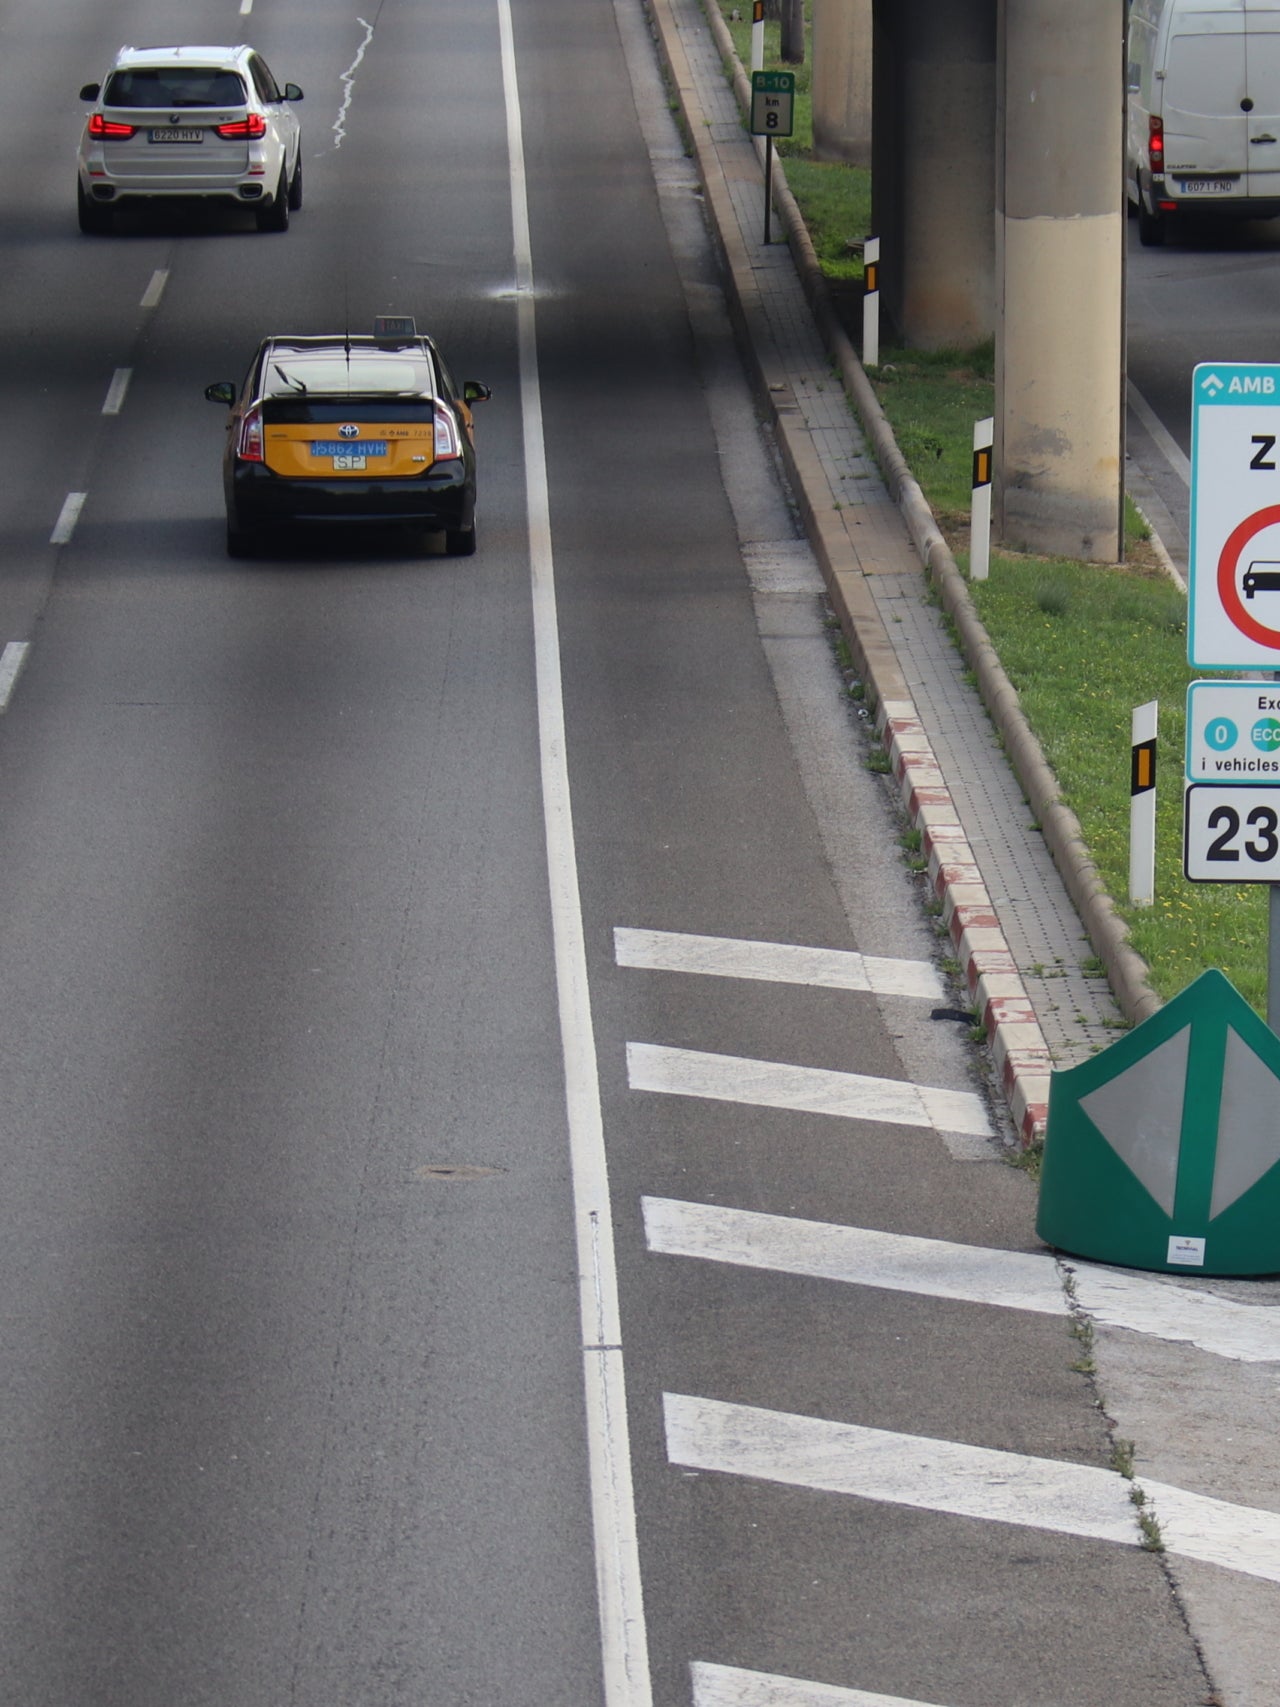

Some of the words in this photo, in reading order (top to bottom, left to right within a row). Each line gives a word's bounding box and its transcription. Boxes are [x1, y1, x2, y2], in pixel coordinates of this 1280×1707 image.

[757, 76, 789, 88] B-10
[765, 96, 779, 106] km
[766, 111, 778, 128] 8
[1187, 182, 1210, 191] 6071
[1228, 376, 1275, 394] AMB
[320, 442, 353, 454] 5862
[358, 443, 384, 454] HVH
[338, 457, 361, 469] SP
[1202, 758, 1206, 771] i
[1215, 758, 1279, 772] vehicles
[1206, 805, 1279, 862] 23
